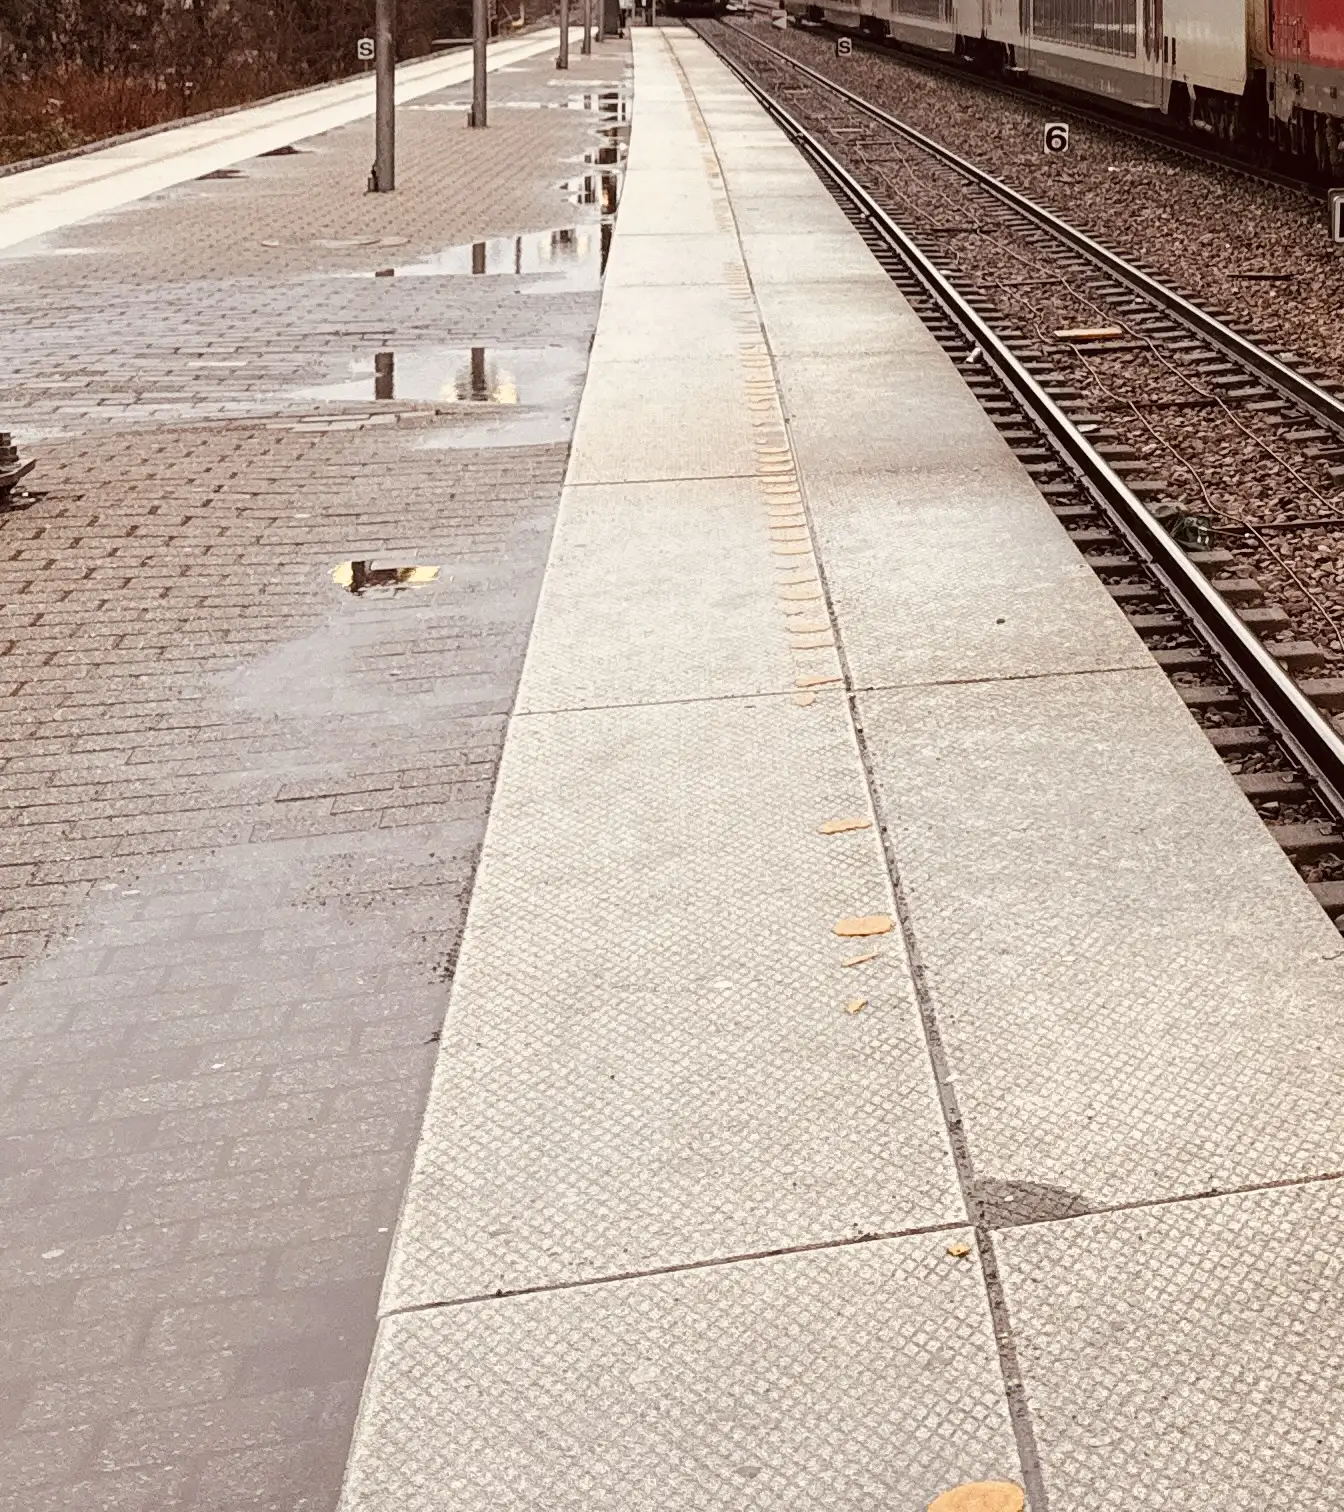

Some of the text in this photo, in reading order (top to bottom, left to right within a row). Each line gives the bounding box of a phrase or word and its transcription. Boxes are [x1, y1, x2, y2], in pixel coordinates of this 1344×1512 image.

[360, 41, 373, 57] S
[838, 40, 851, 54] S
[1046, 125, 1067, 152] 6
